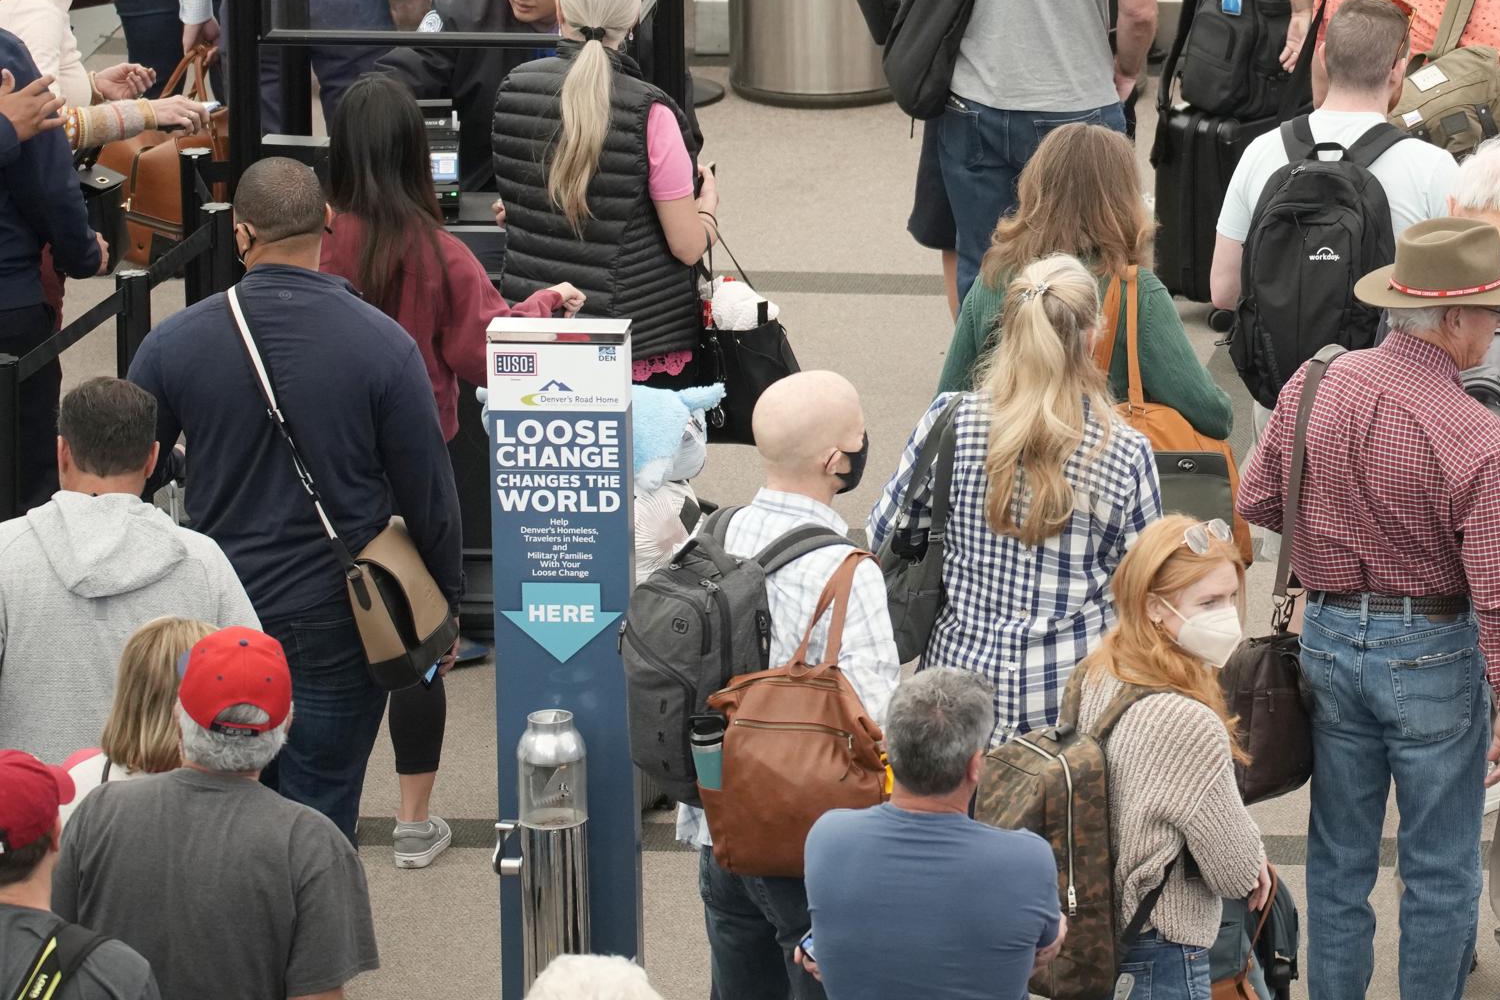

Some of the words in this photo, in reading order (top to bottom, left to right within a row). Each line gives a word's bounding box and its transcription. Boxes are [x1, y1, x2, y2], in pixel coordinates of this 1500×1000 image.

[503, 356, 528, 372] USO
[540, 395, 573, 404] Denver's
[575, 396, 594, 404] Road
[596, 396, 619, 404] Home
[496, 419, 619, 445] LOOSE
[496, 446, 620, 468] CHANGE
[496, 474, 581, 488] CHANGES
[585, 475, 620, 488] THE
[496, 489, 621, 513] WORLD
[550, 518, 569, 527] Help
[520, 526, 556, 534] Denver's
[557, 527, 599, 535] Homeless,
[572, 536, 596, 544] Need,
[528, 552, 558, 561] Military
[560, 552, 593, 560] Families
[540, 560, 560, 568] With
[558, 570, 590, 578] Change
[528, 604, 595, 622] HERE
